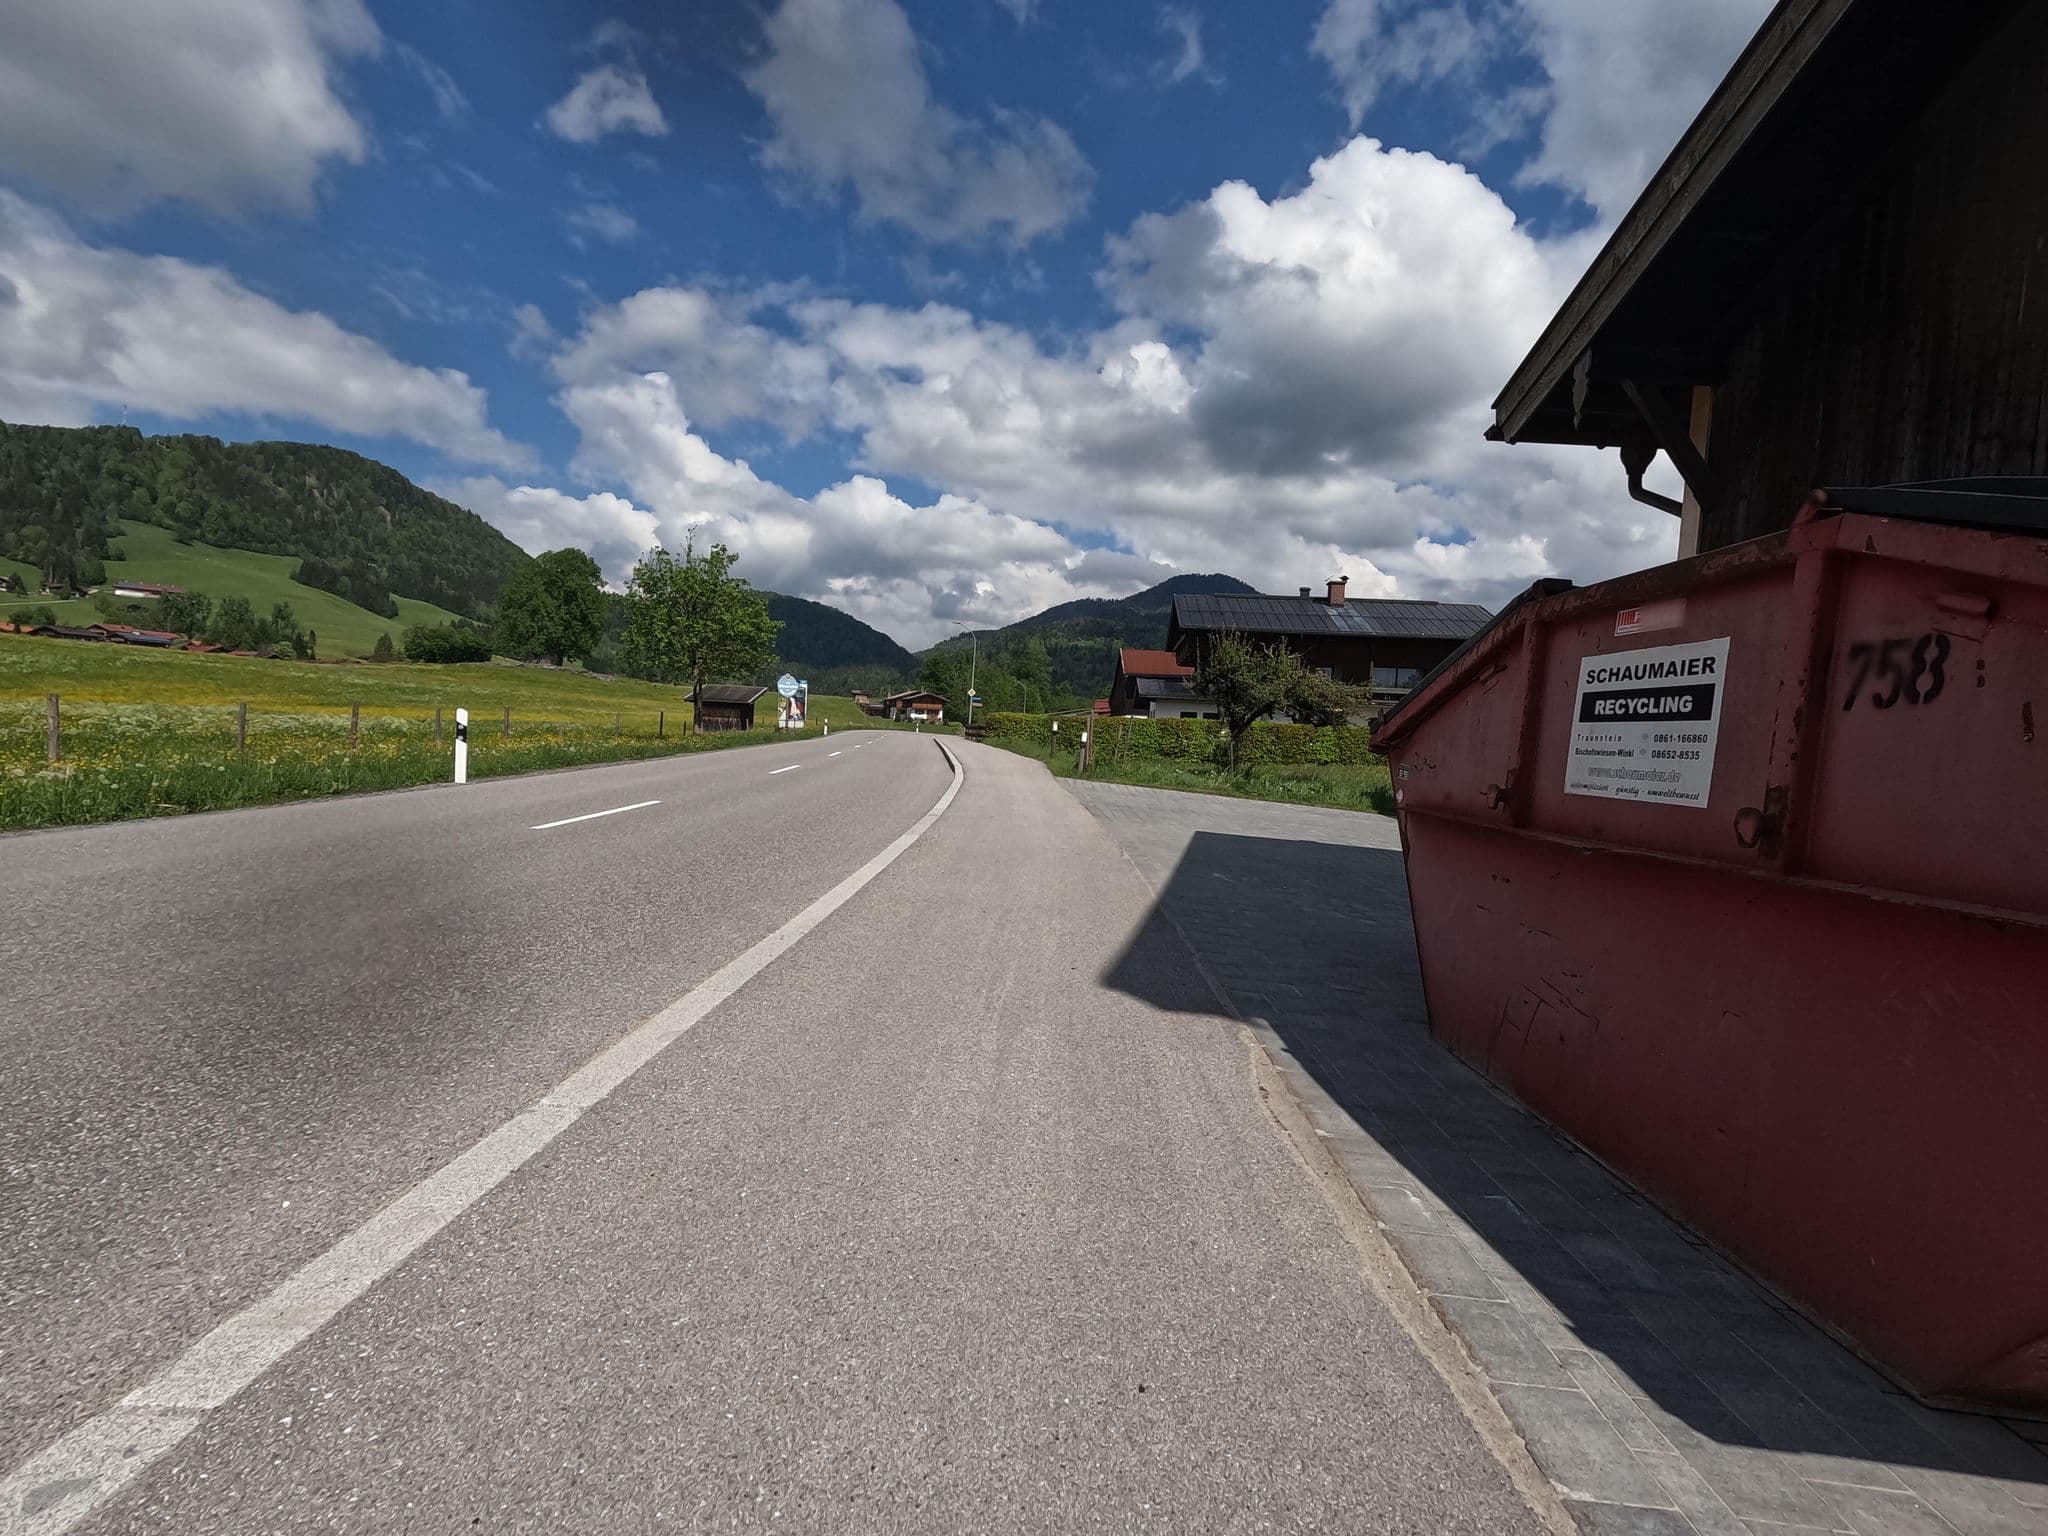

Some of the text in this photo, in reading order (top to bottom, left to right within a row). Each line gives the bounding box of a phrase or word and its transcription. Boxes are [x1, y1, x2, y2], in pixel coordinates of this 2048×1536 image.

[1586, 656, 1717, 685] SCHAUMAIER
[1842, 632, 1951, 711] 758
[1594, 695, 1694, 716] RECYCLING
[1577, 733, 1709, 744] Traunstein 0861-166860
[1651, 749, 1701, 760] 08652-8535
[1588, 766, 1681, 783] schaumaier.de
